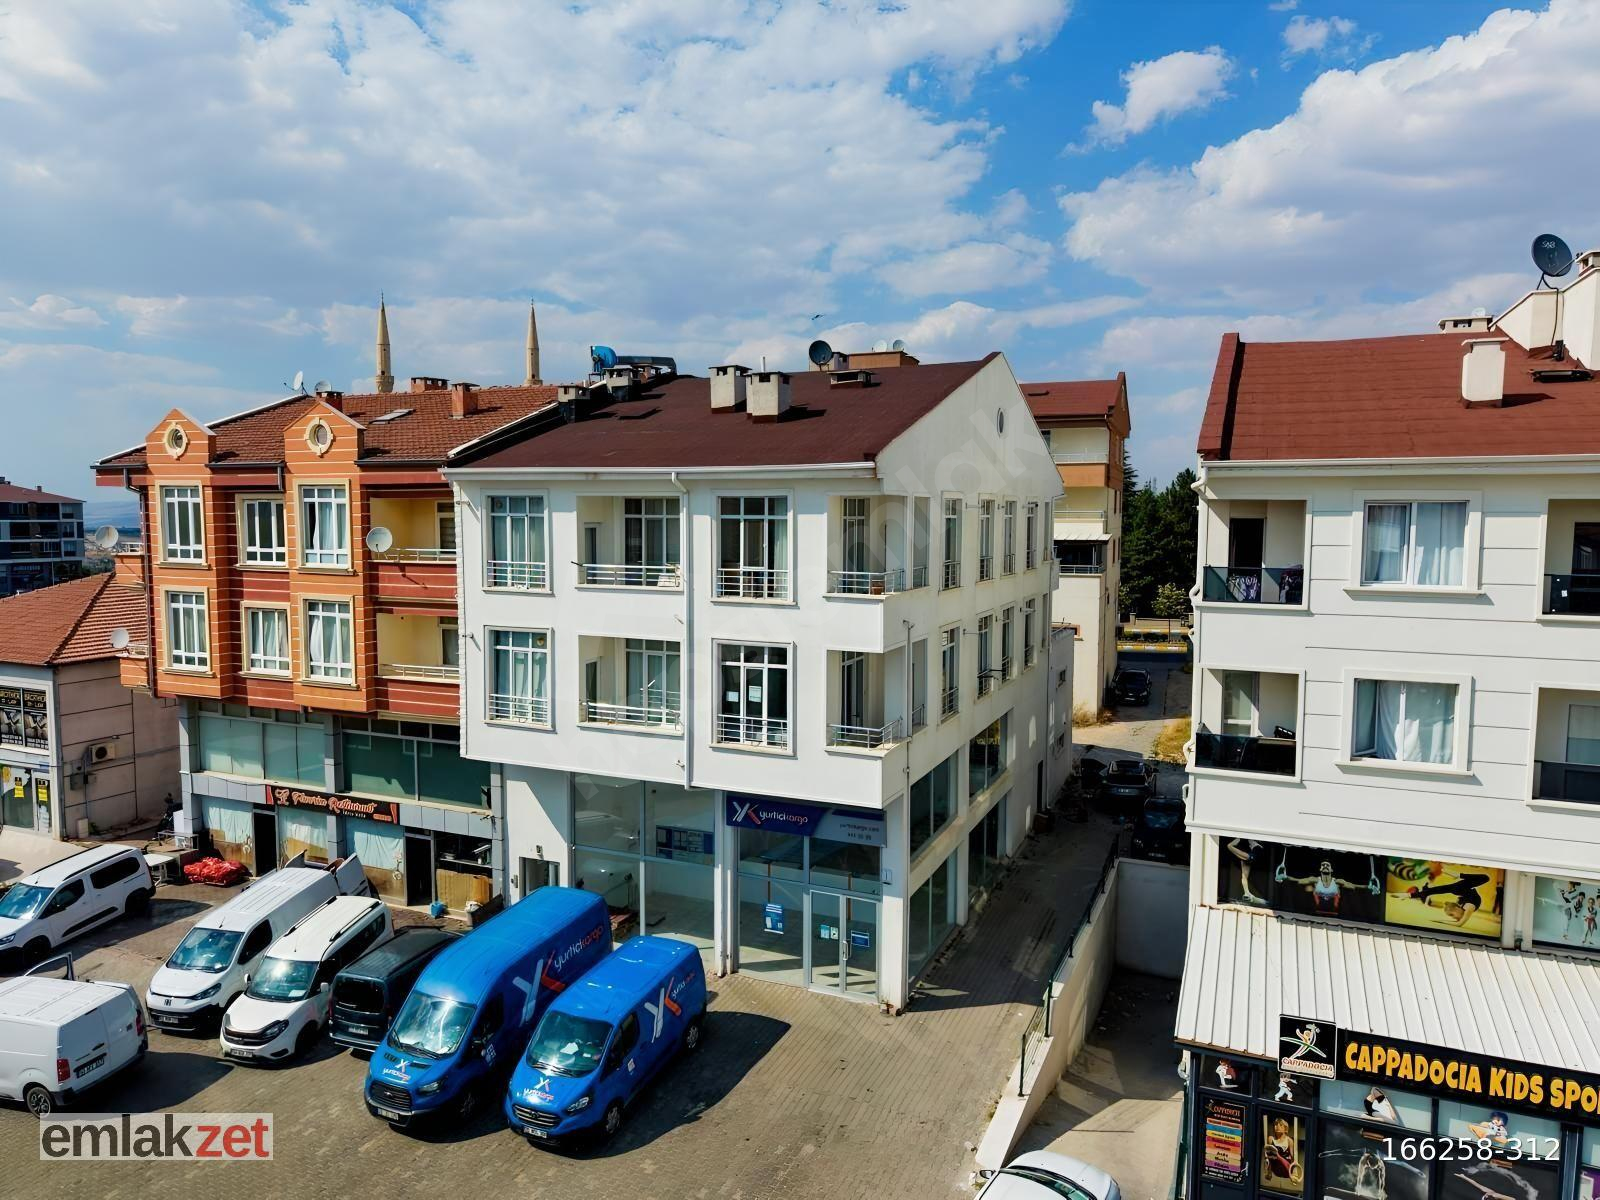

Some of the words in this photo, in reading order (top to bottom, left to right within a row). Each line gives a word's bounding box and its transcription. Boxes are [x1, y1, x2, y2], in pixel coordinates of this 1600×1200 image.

[1345, 1041, 1482, 1093] CAPPADOCIA
[1489, 1066, 1544, 1104] KIDS
[1550, 1077, 1600, 1114] SPO
